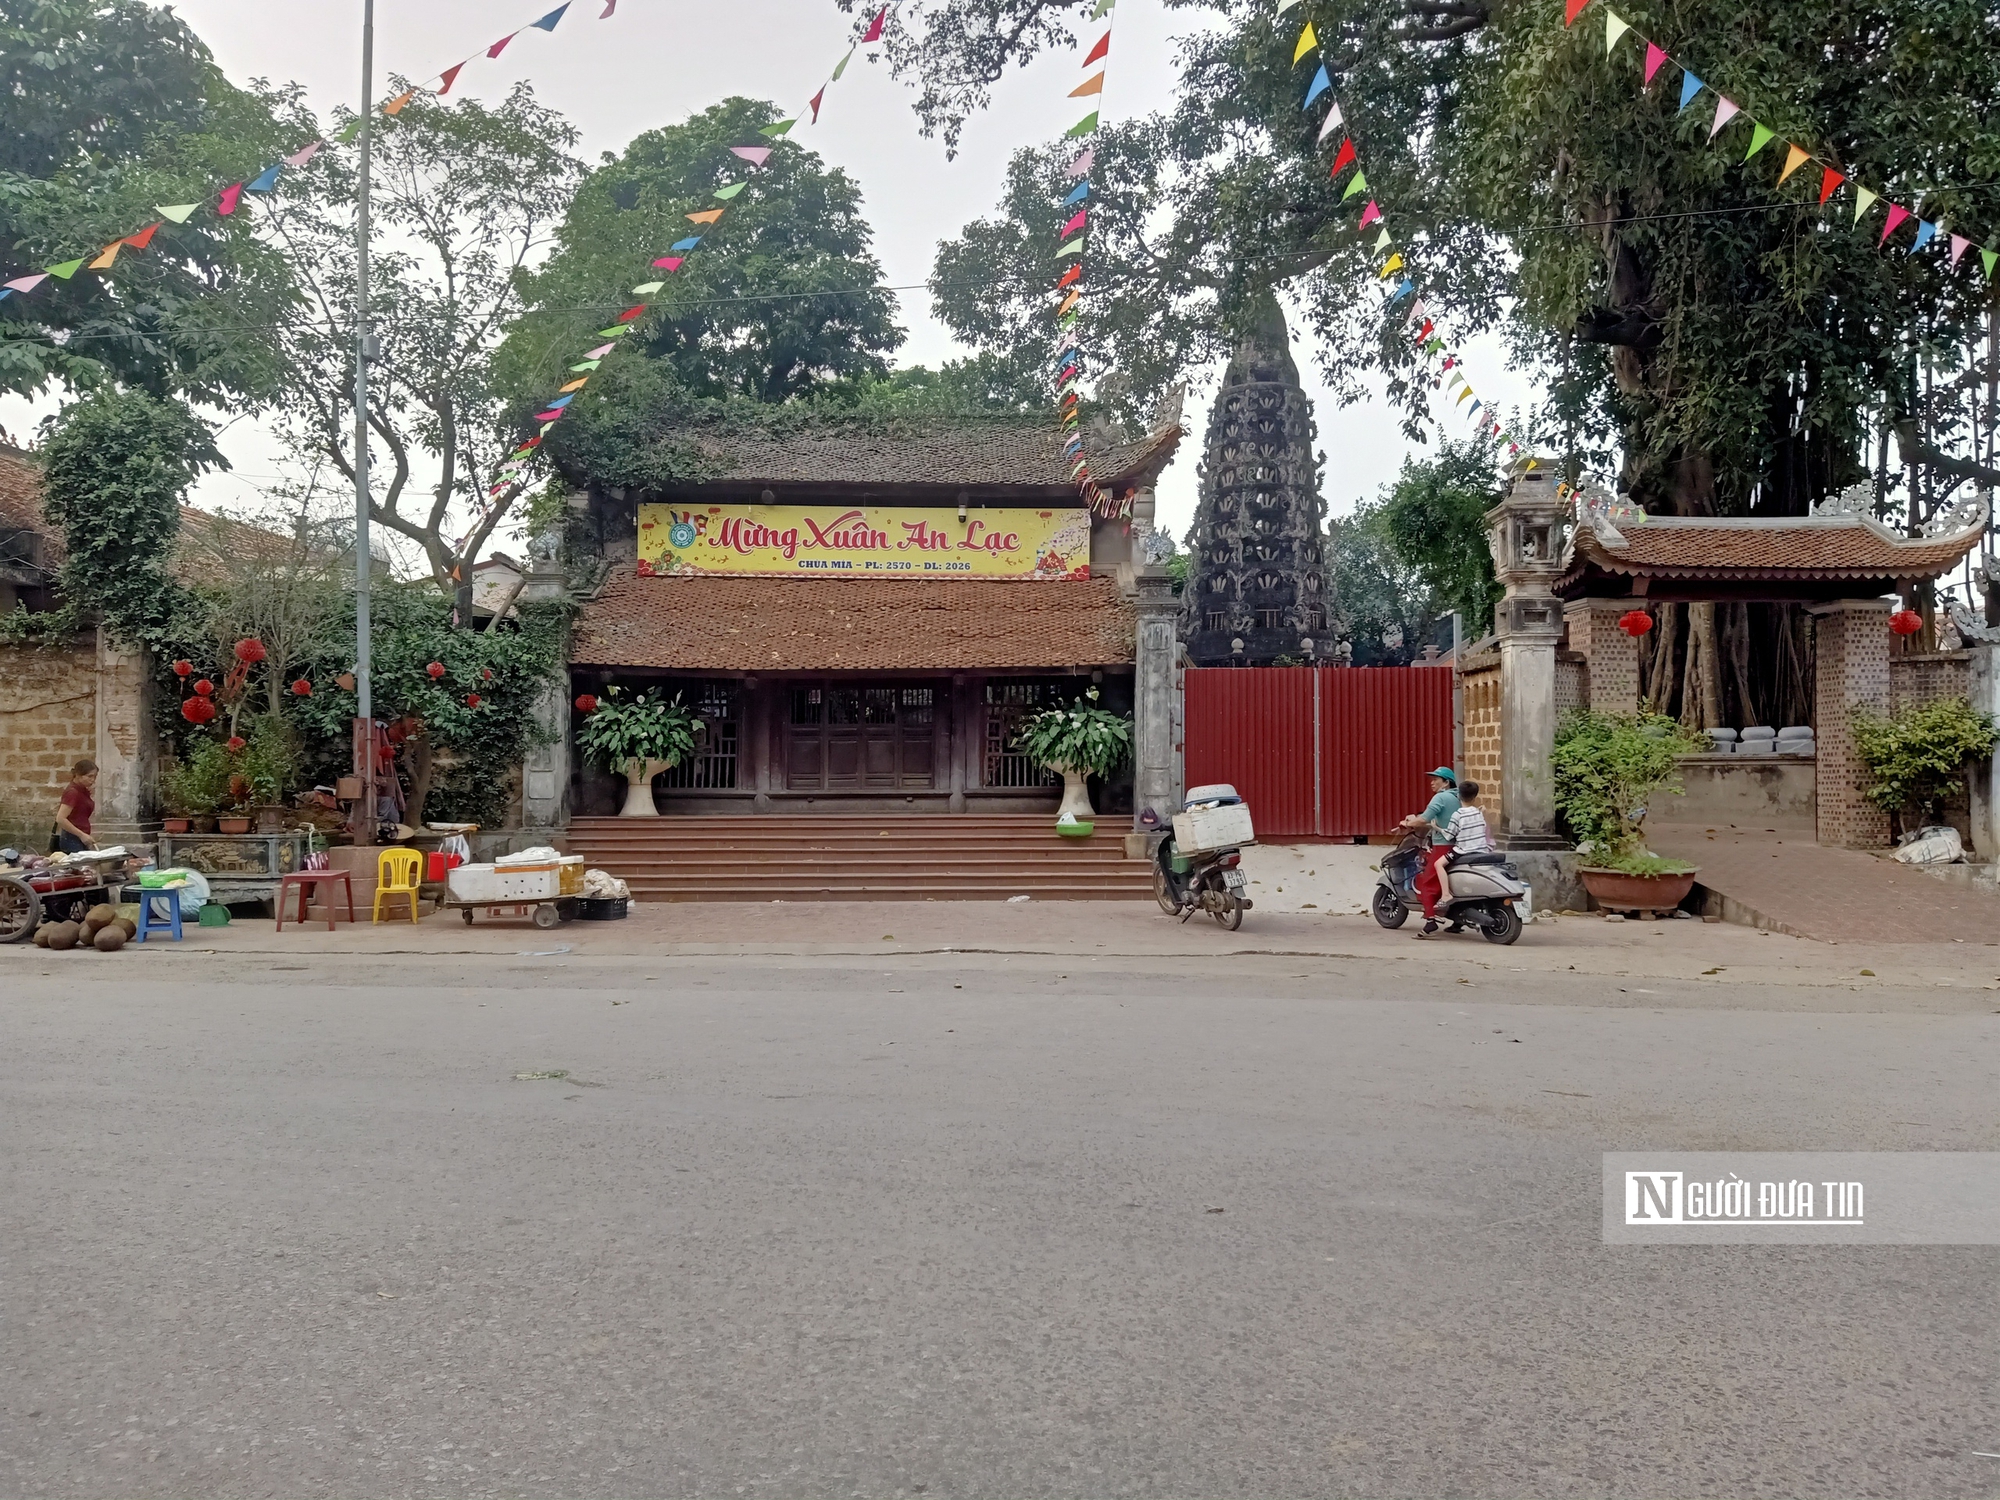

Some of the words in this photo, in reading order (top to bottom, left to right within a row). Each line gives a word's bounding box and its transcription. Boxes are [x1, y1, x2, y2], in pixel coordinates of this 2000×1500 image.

[707, 517, 799, 559] Mừng
[802, 510, 892, 549] Xuân
[896, 520, 951, 550] An
[956, 520, 1021, 557] Lạc
[831, 559, 853, 569] MÍA
[865, 561, 883, 569] PL:
[886, 561, 912, 570] 2570
[923, 562, 942, 570] DL:
[945, 562, 971, 570] 2026
